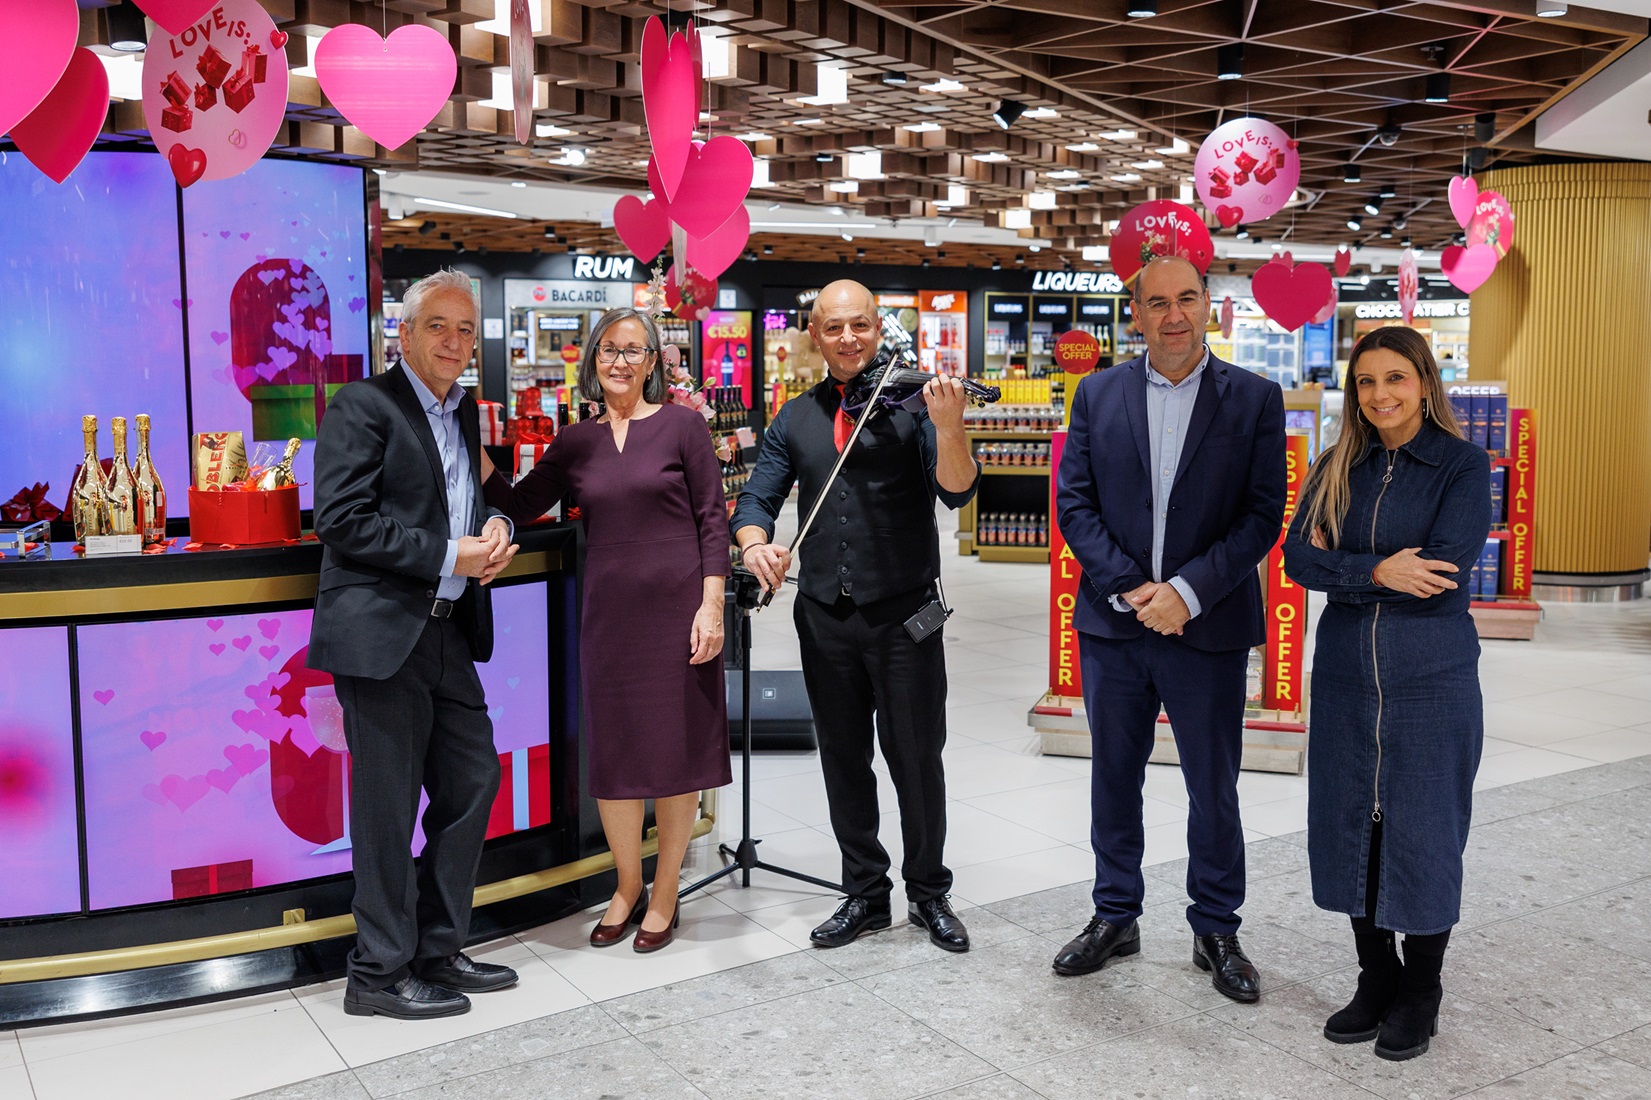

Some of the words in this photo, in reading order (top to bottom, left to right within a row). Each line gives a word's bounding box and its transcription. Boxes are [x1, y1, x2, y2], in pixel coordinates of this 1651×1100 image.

[169, 6, 227, 59] LOVE
[226, 20, 251, 45] IS:
[1214, 130, 1255, 159] LOVE
[1476, 198, 1497, 215] LOVE
[1135, 211, 1177, 231] LOVE
[574, 255, 634, 279] RUM
[1032, 270, 1124, 293] LIQUEURS
[551, 286, 607, 302] BACARDÍ
[707, 325, 748, 338] €15.50
[1058, 343, 1096, 352] SPECIAL
[1062, 351, 1092, 360] OFFER
[1515, 417, 1530, 513] SPECIAL
[1513, 522, 1528, 590] OFFER
[1057, 593, 1076, 686] OFFER
[1275, 603, 1296, 700] OFFER
